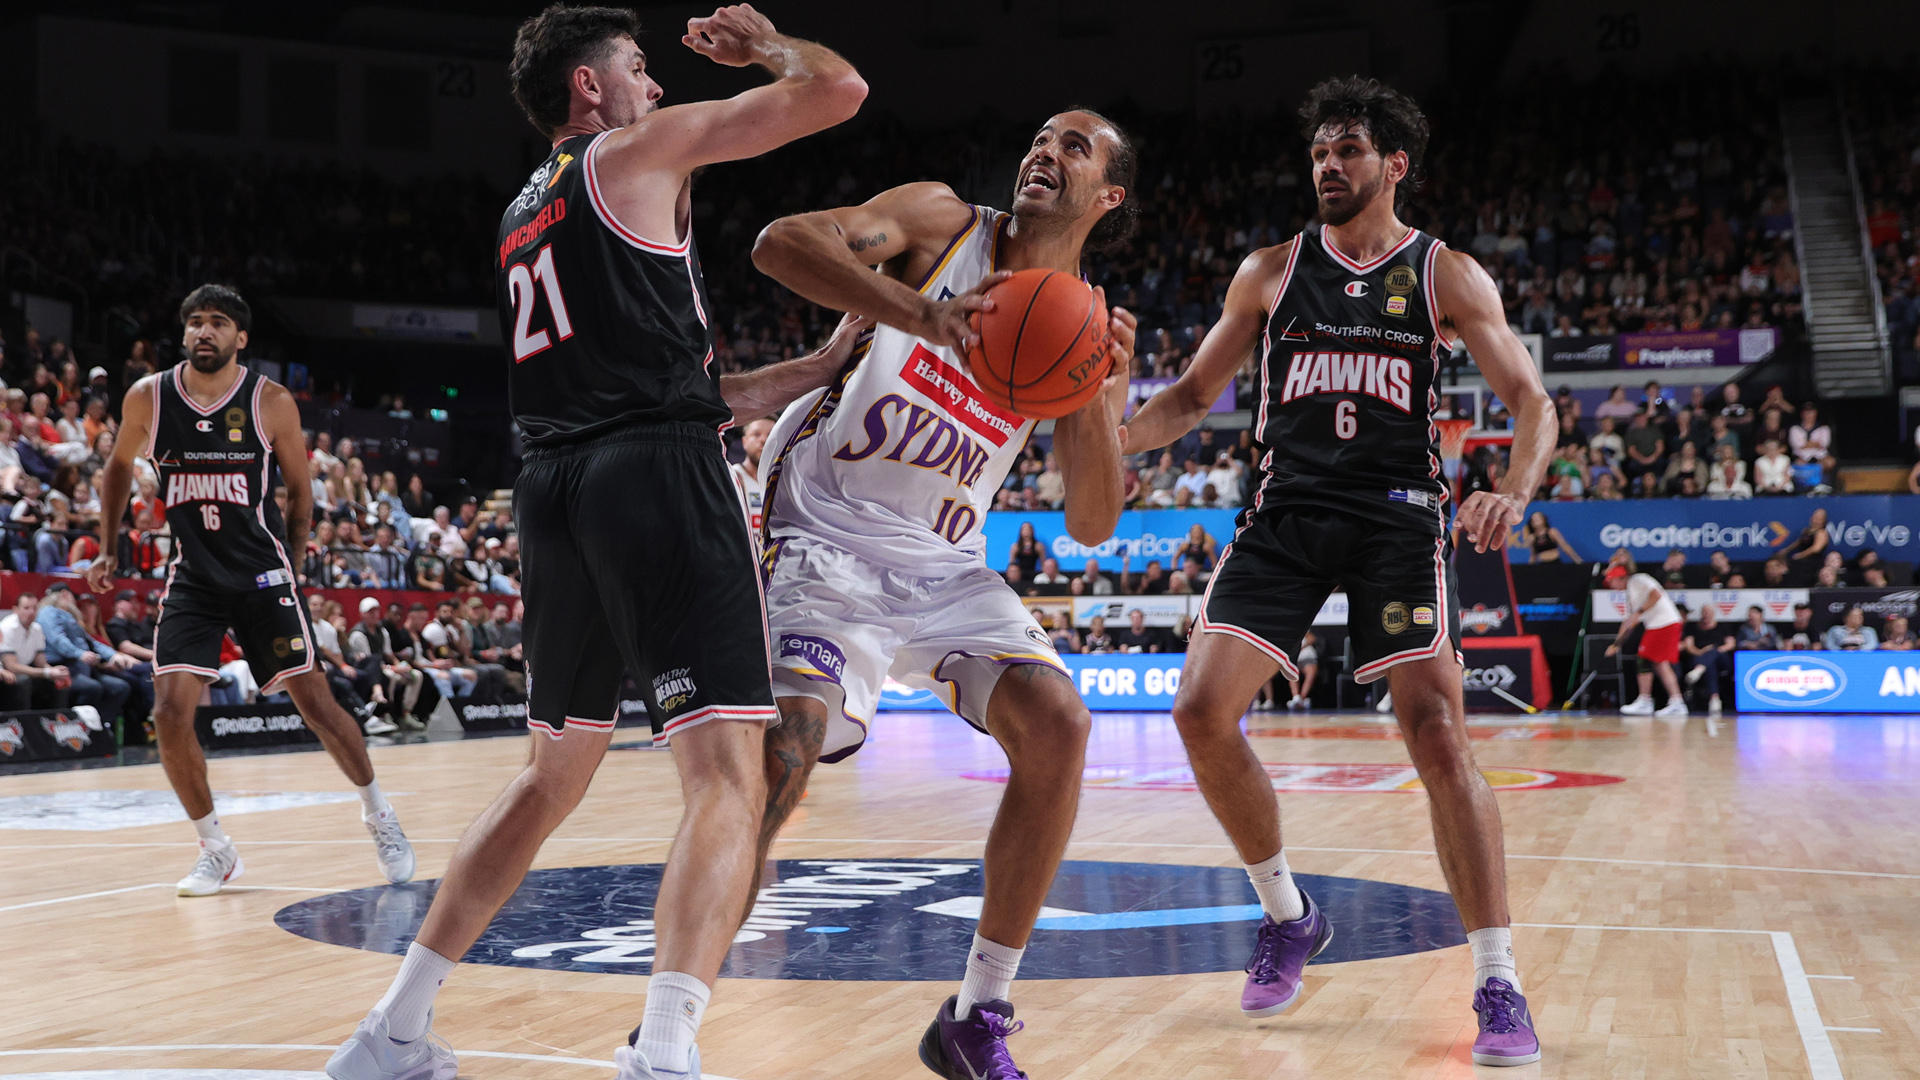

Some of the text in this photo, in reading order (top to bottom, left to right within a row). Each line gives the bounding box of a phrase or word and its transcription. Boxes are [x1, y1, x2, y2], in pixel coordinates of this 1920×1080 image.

[1596, 12, 1640, 50] 26
[438, 62, 475, 98] 23
[1203, 44, 1244, 80] 25
[500, 198, 566, 269] ANCHFIELD
[1391, 274, 1409, 286] NBL
[508, 242, 574, 364] 21
[1315, 322, 1424, 345] SOUTHERN CROSS
[1067, 332, 1113, 389] SPALD
[913, 359, 966, 405] Harvey
[1281, 352, 1412, 415] HAWKS
[1335, 400, 1357, 440] 6
[184, 452, 256, 461] SOUTHERN CROSS
[832, 393, 990, 490] SYDNE
[166, 473, 250, 509] HAWKS
[199, 503, 221, 531] 16
[931, 497, 977, 545] 10
[1600, 522, 1769, 548] GreaterBank
[1052, 532, 1191, 558] GreatrBan
[1387, 613, 1404, 625] NBL
[653, 667, 690, 688] HEALTHY
[656, 677, 693, 701] DEADLY
[1080, 667, 1180, 696] FOR GO
[664, 694, 688, 712] KIDS
